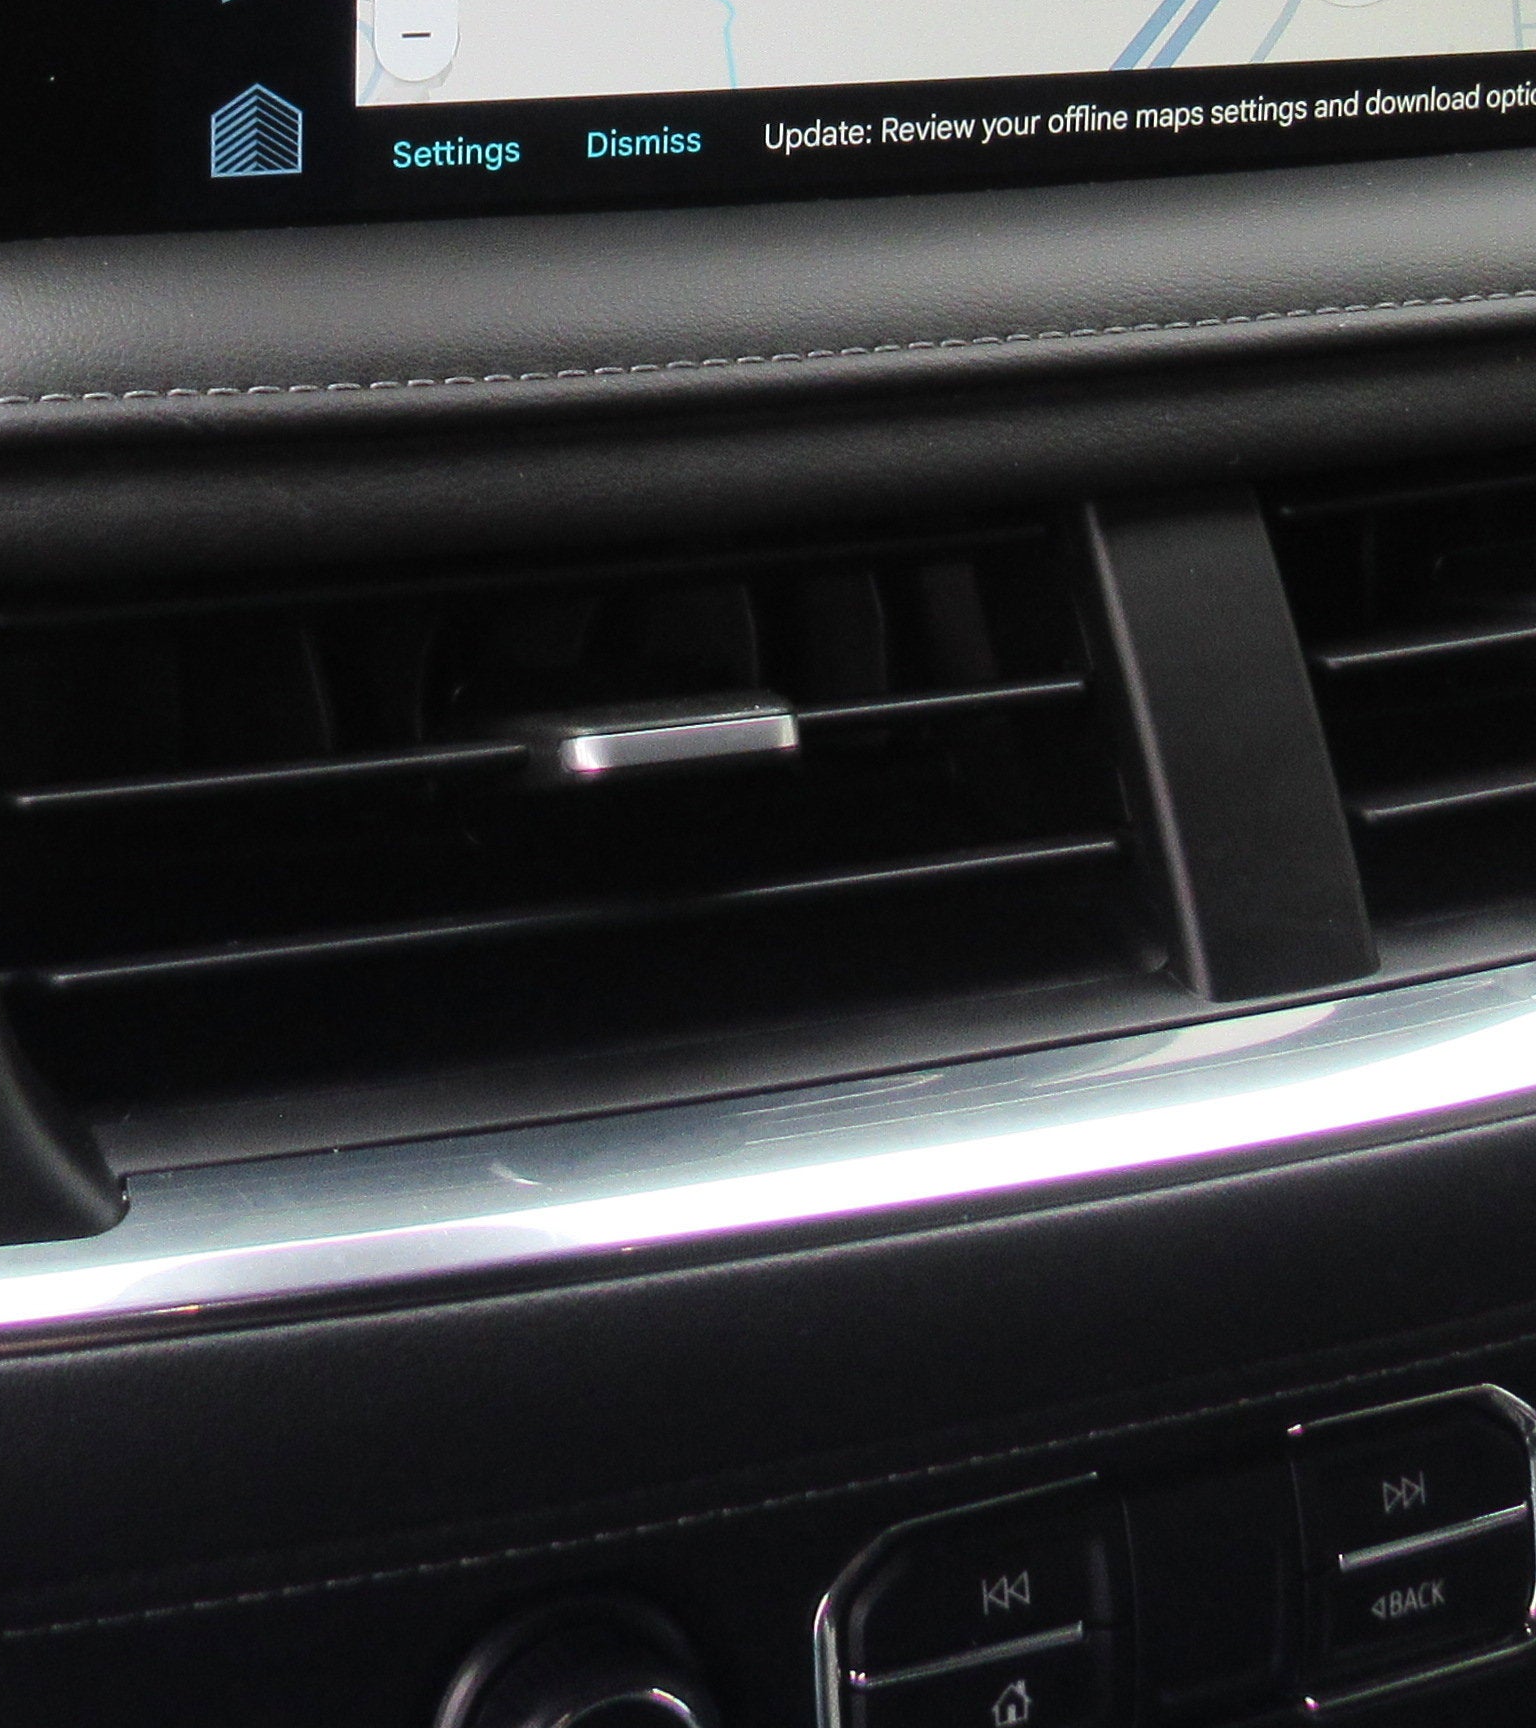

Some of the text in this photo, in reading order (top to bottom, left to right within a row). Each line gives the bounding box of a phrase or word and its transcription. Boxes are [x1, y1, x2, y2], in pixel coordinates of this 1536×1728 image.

[764, 118, 872, 156] Update:
[881, 113, 976, 144] Review
[982, 113, 1041, 145] your
[1048, 102, 1128, 134] offline
[1135, 103, 1204, 133] maps
[1210, 95, 1308, 127] settings
[1313, 89, 1359, 119] and
[1365, 83, 1481, 117] download
[392, 138, 521, 171] Settings
[587, 126, 701, 158] Dismiss
[1390, 1579, 1446, 1618] BACK
